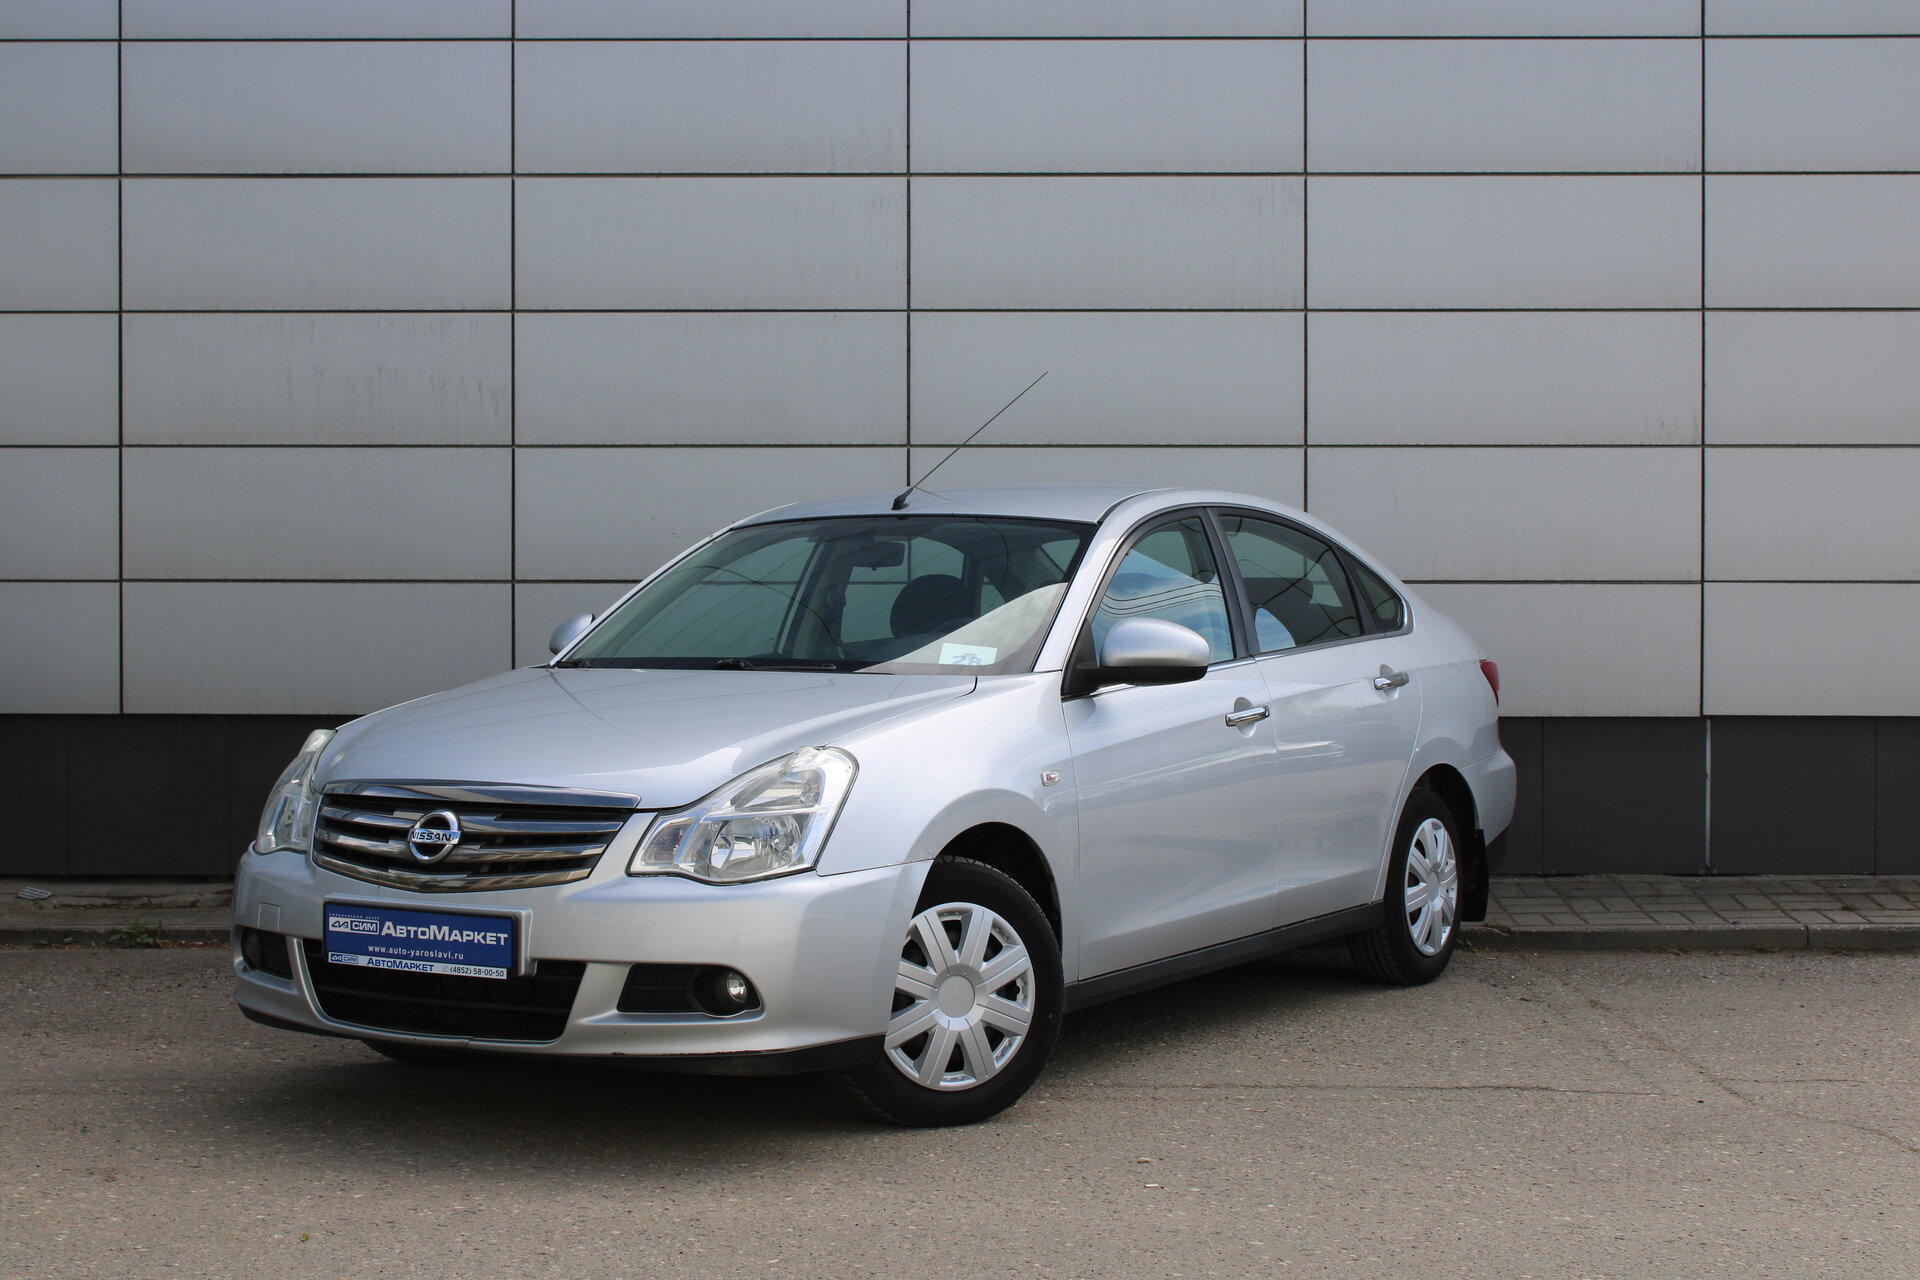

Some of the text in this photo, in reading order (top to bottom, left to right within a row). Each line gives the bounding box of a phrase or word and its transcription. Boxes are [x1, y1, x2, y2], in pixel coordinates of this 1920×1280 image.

[410, 831, 451, 842] NISSAN
[367, 944, 464, 960] www.auto-yaroslavl.ru
[450, 966, 472, 975] (4852)
[473, 968, 505, 978] 58-00-50
